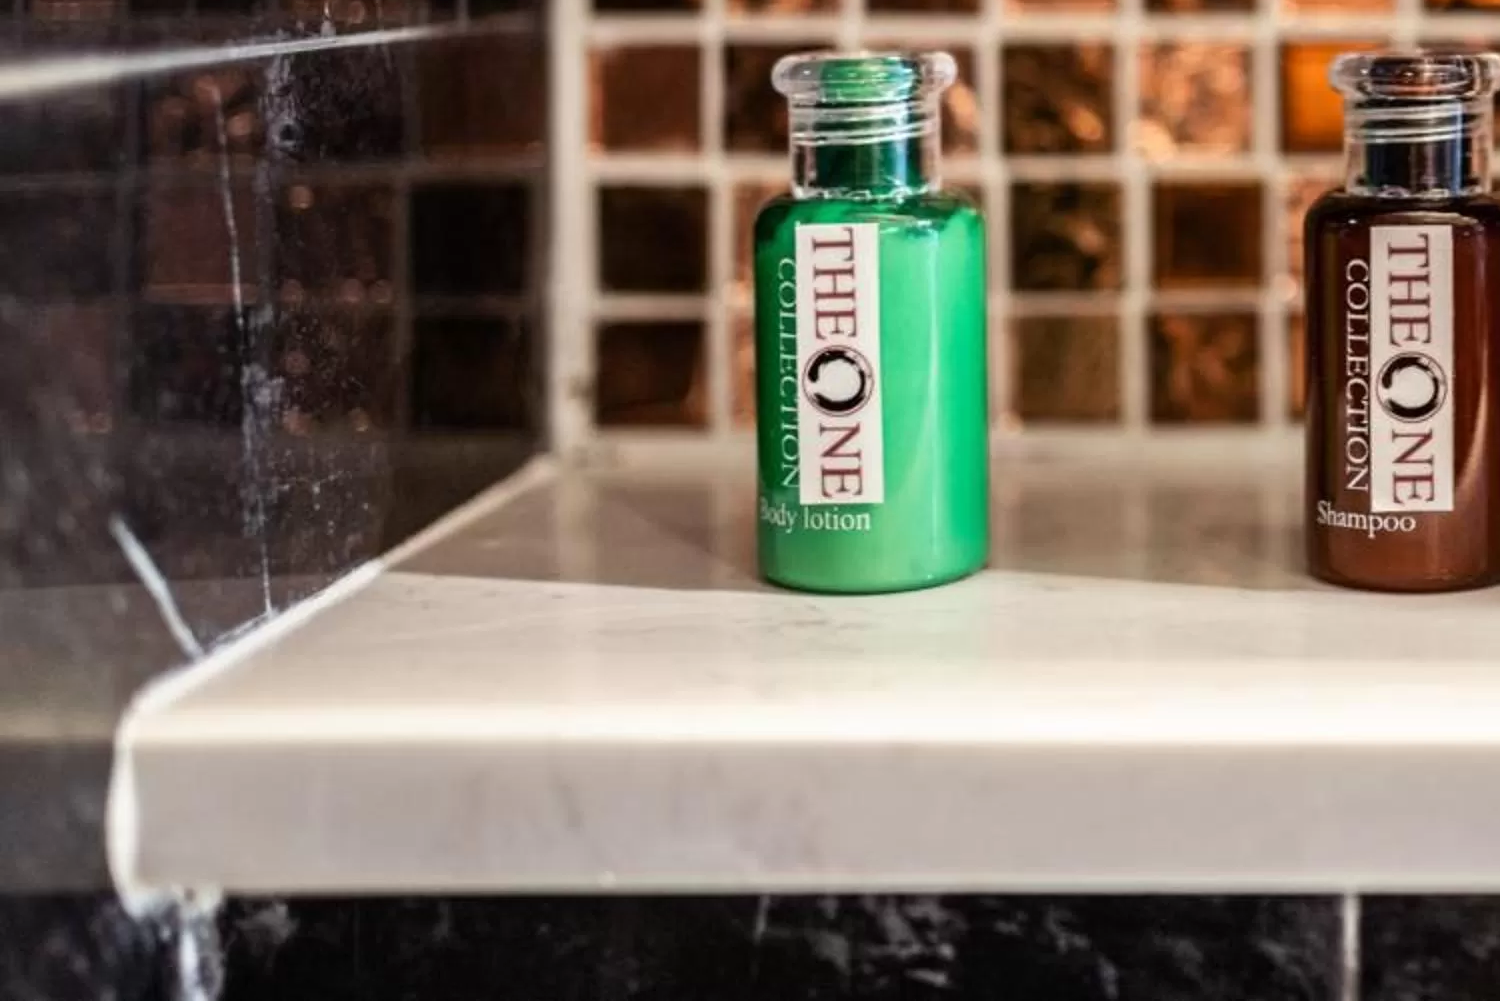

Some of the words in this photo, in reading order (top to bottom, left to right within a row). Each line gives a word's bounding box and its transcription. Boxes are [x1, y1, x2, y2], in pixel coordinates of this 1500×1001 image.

[811, 227, 858, 339] THE
[1387, 233, 1432, 347] THE
[776, 258, 801, 489] COLLECTION
[802, 345, 875, 498] ONE
[1345, 258, 1370, 491] COLLECTION
[1375, 351, 1448, 504] ONE
[804, 506, 871, 531] lotion
[1316, 499, 1416, 538] Shampoo
